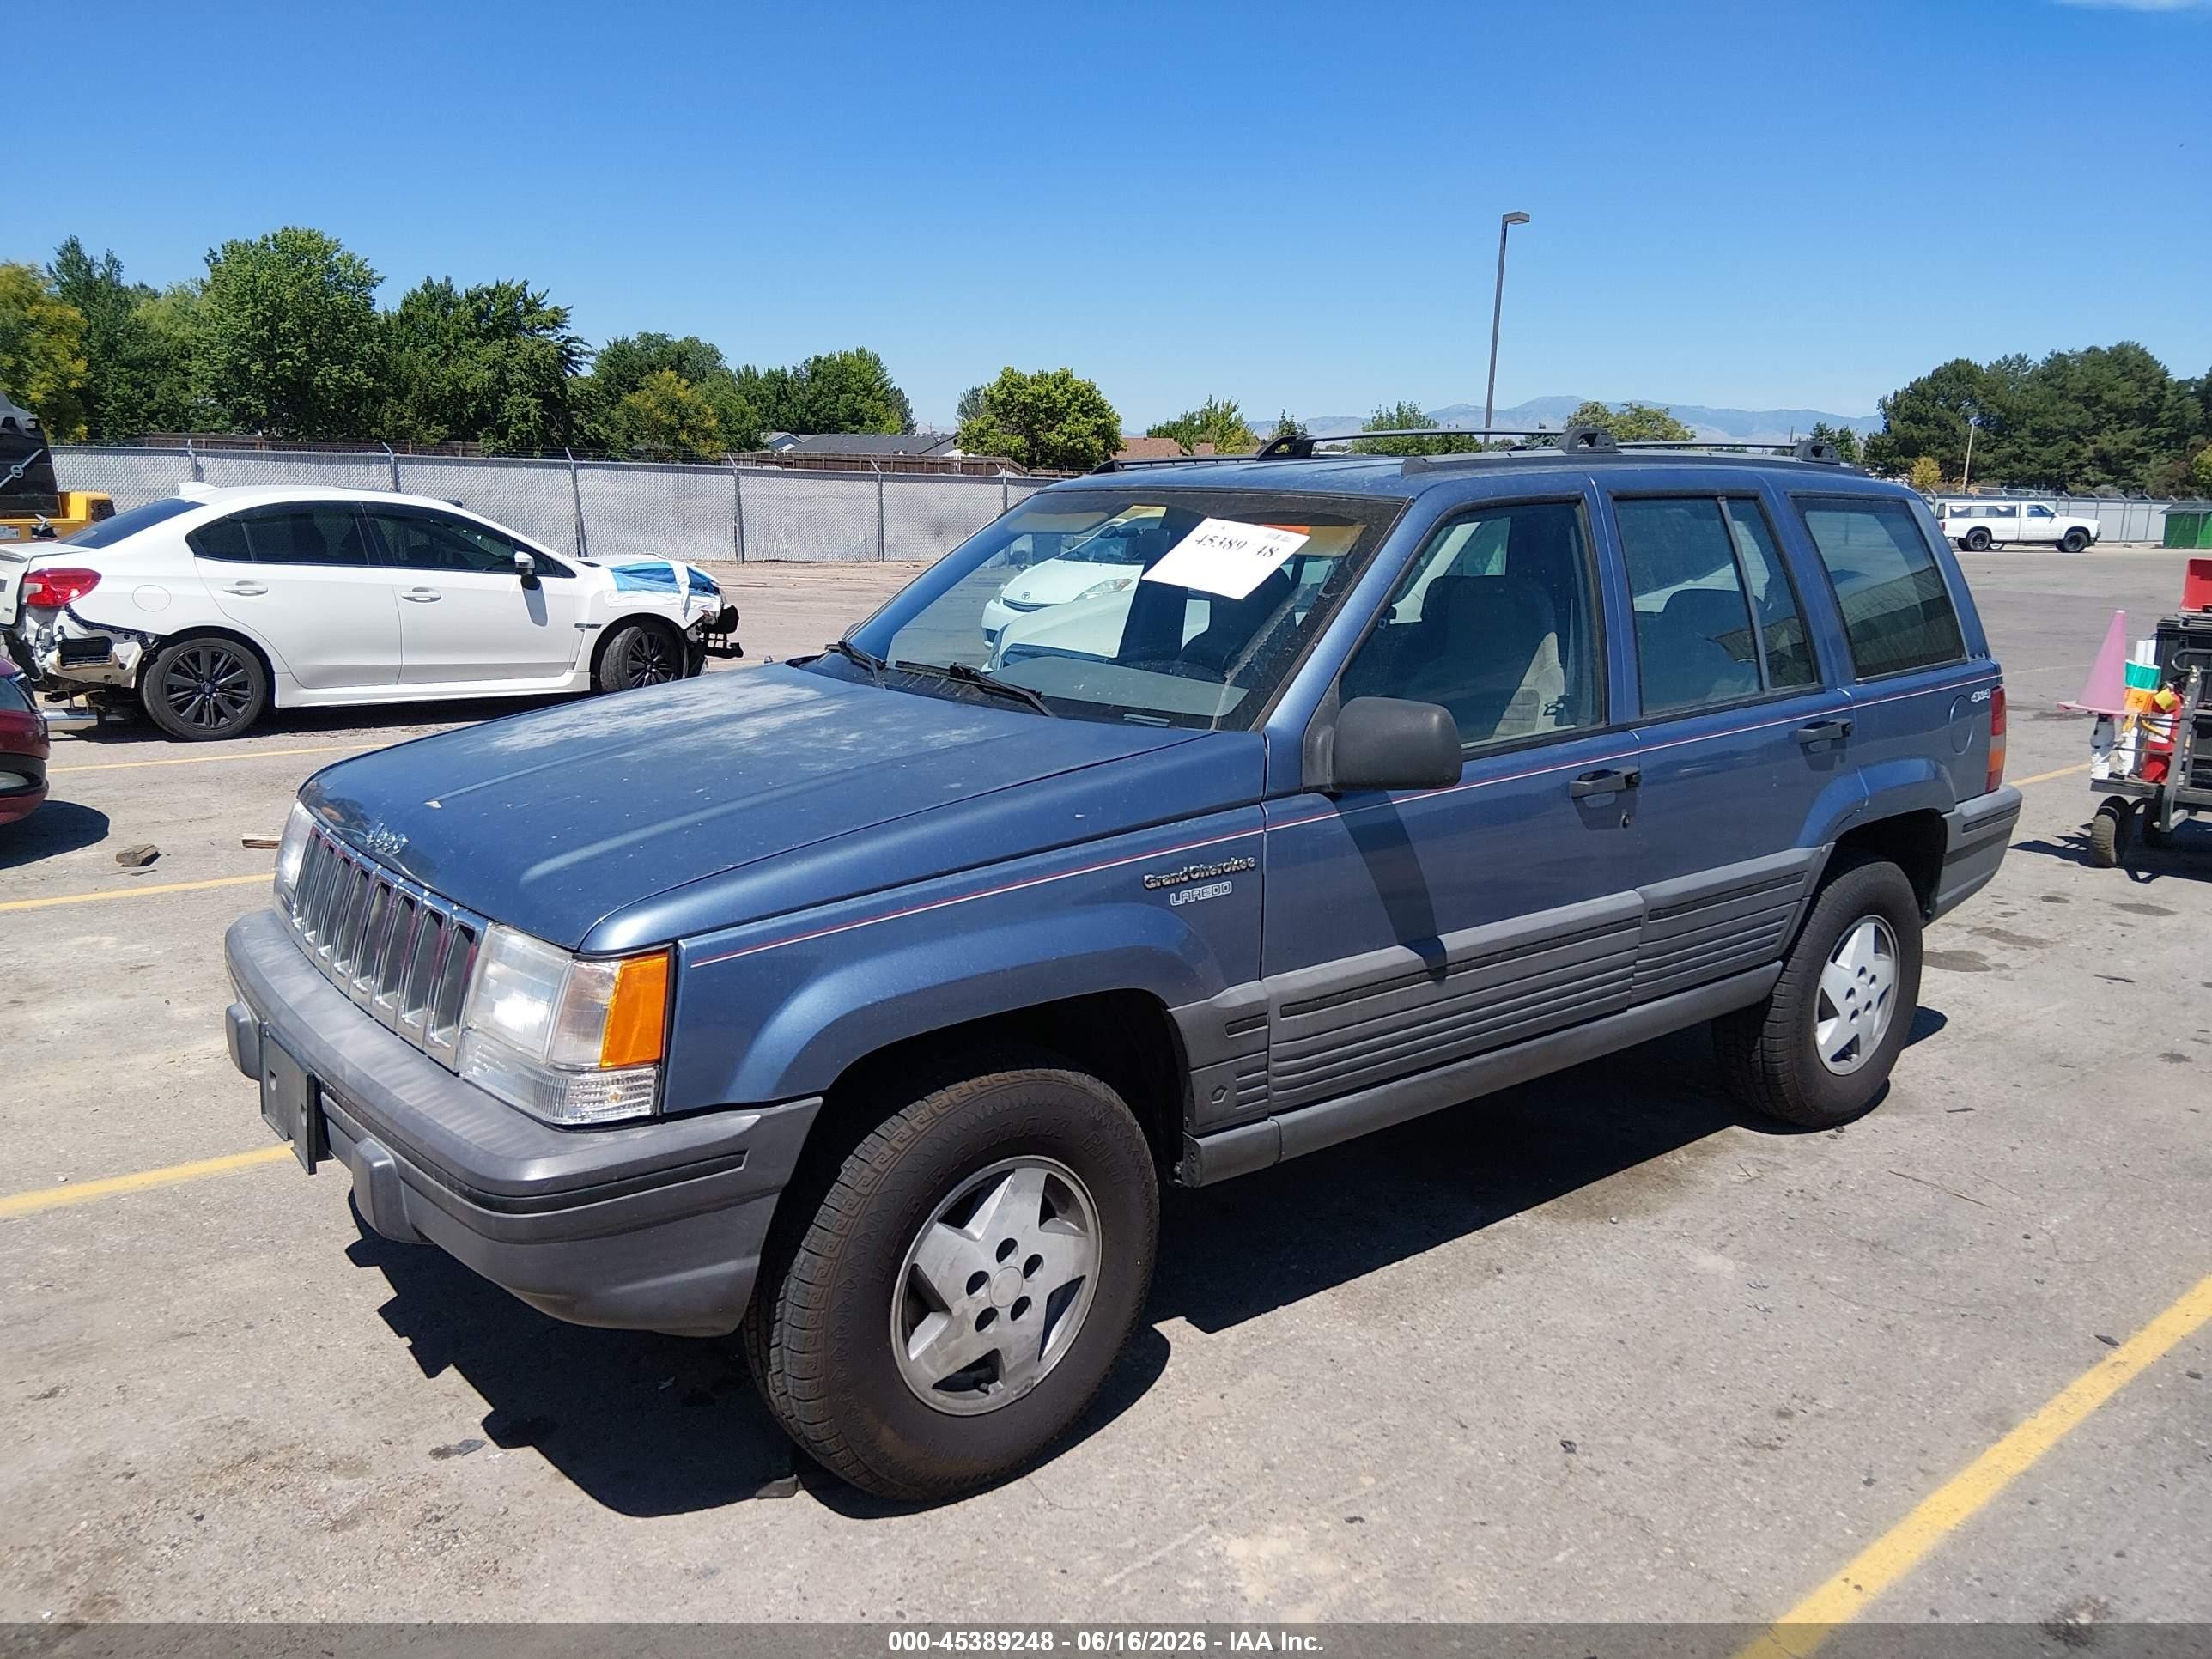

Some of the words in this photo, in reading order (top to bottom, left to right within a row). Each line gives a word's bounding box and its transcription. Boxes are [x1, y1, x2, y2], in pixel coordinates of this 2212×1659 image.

[1143, 866, 1188, 890] Grand
[1188, 856, 1256, 880] Cherokee
[1170, 880, 1233, 907] LAREDO
